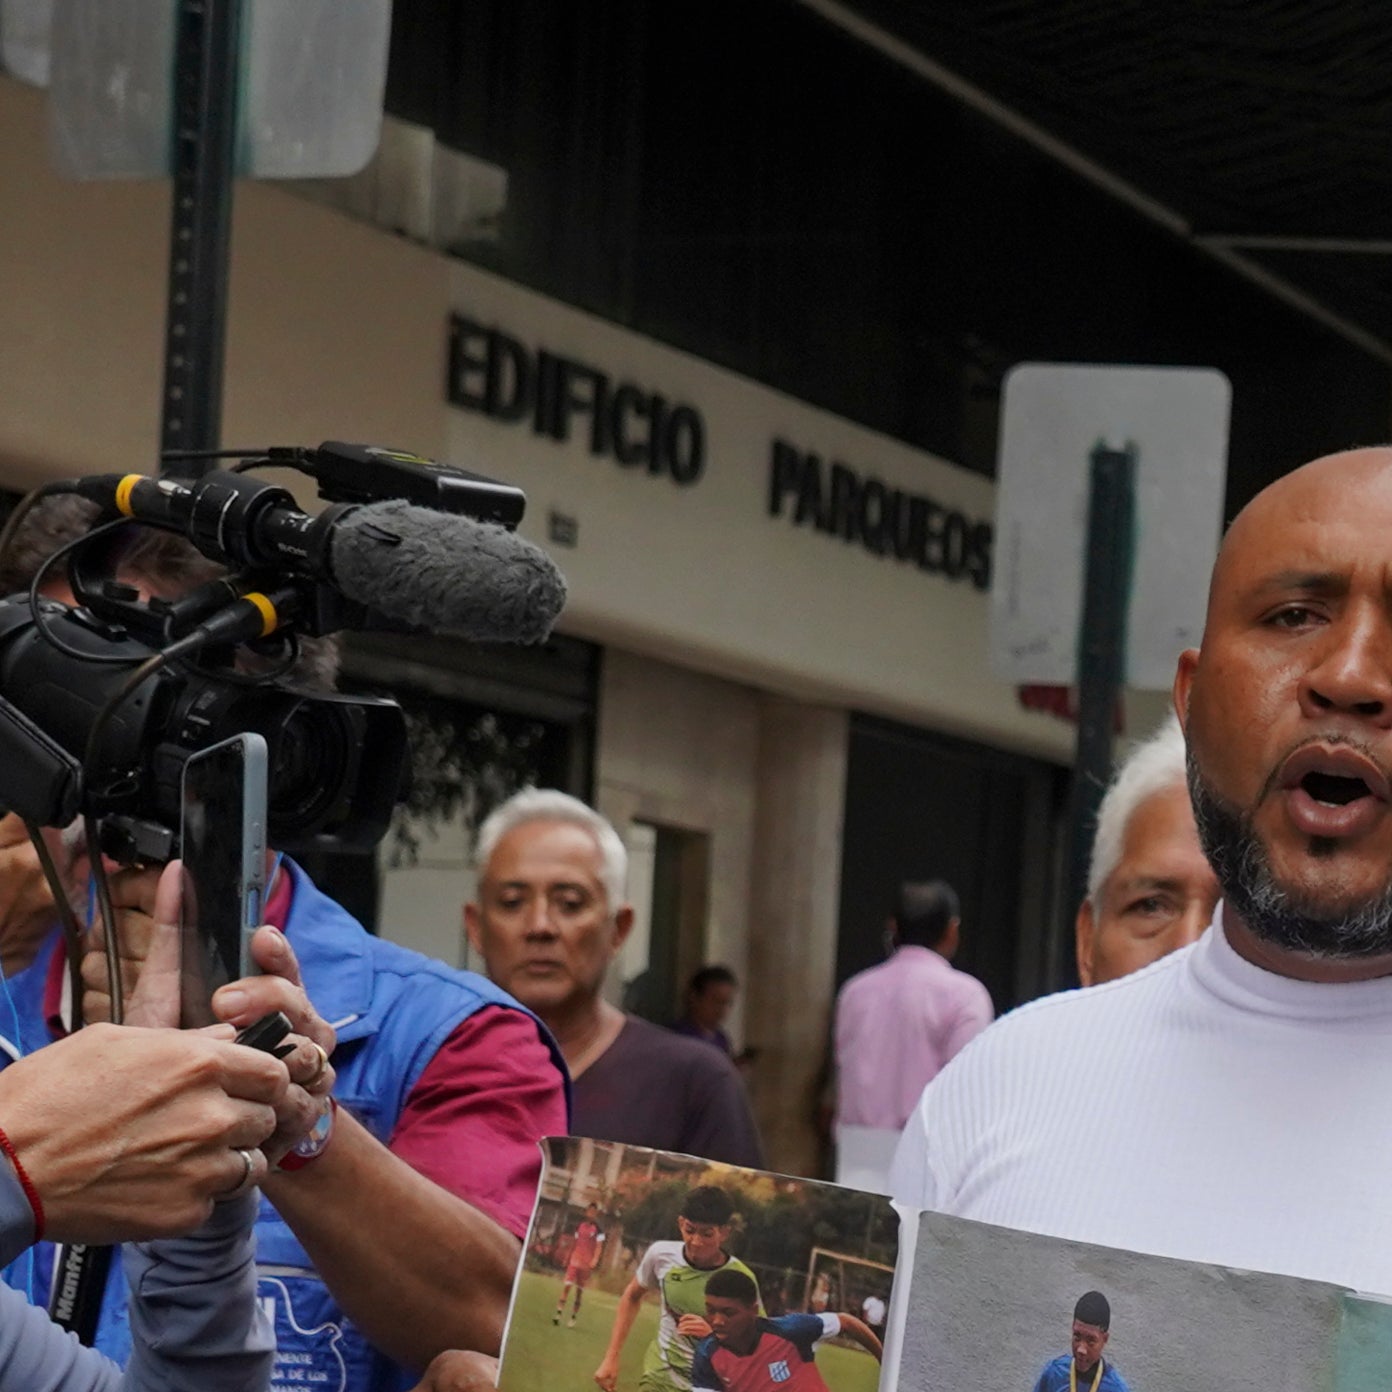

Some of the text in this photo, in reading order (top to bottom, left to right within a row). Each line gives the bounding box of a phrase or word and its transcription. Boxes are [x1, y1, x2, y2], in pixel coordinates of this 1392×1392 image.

[447, 311, 994, 592] EDIFICIO PARQUEOS
[288, 1369, 305, 1381] DE
